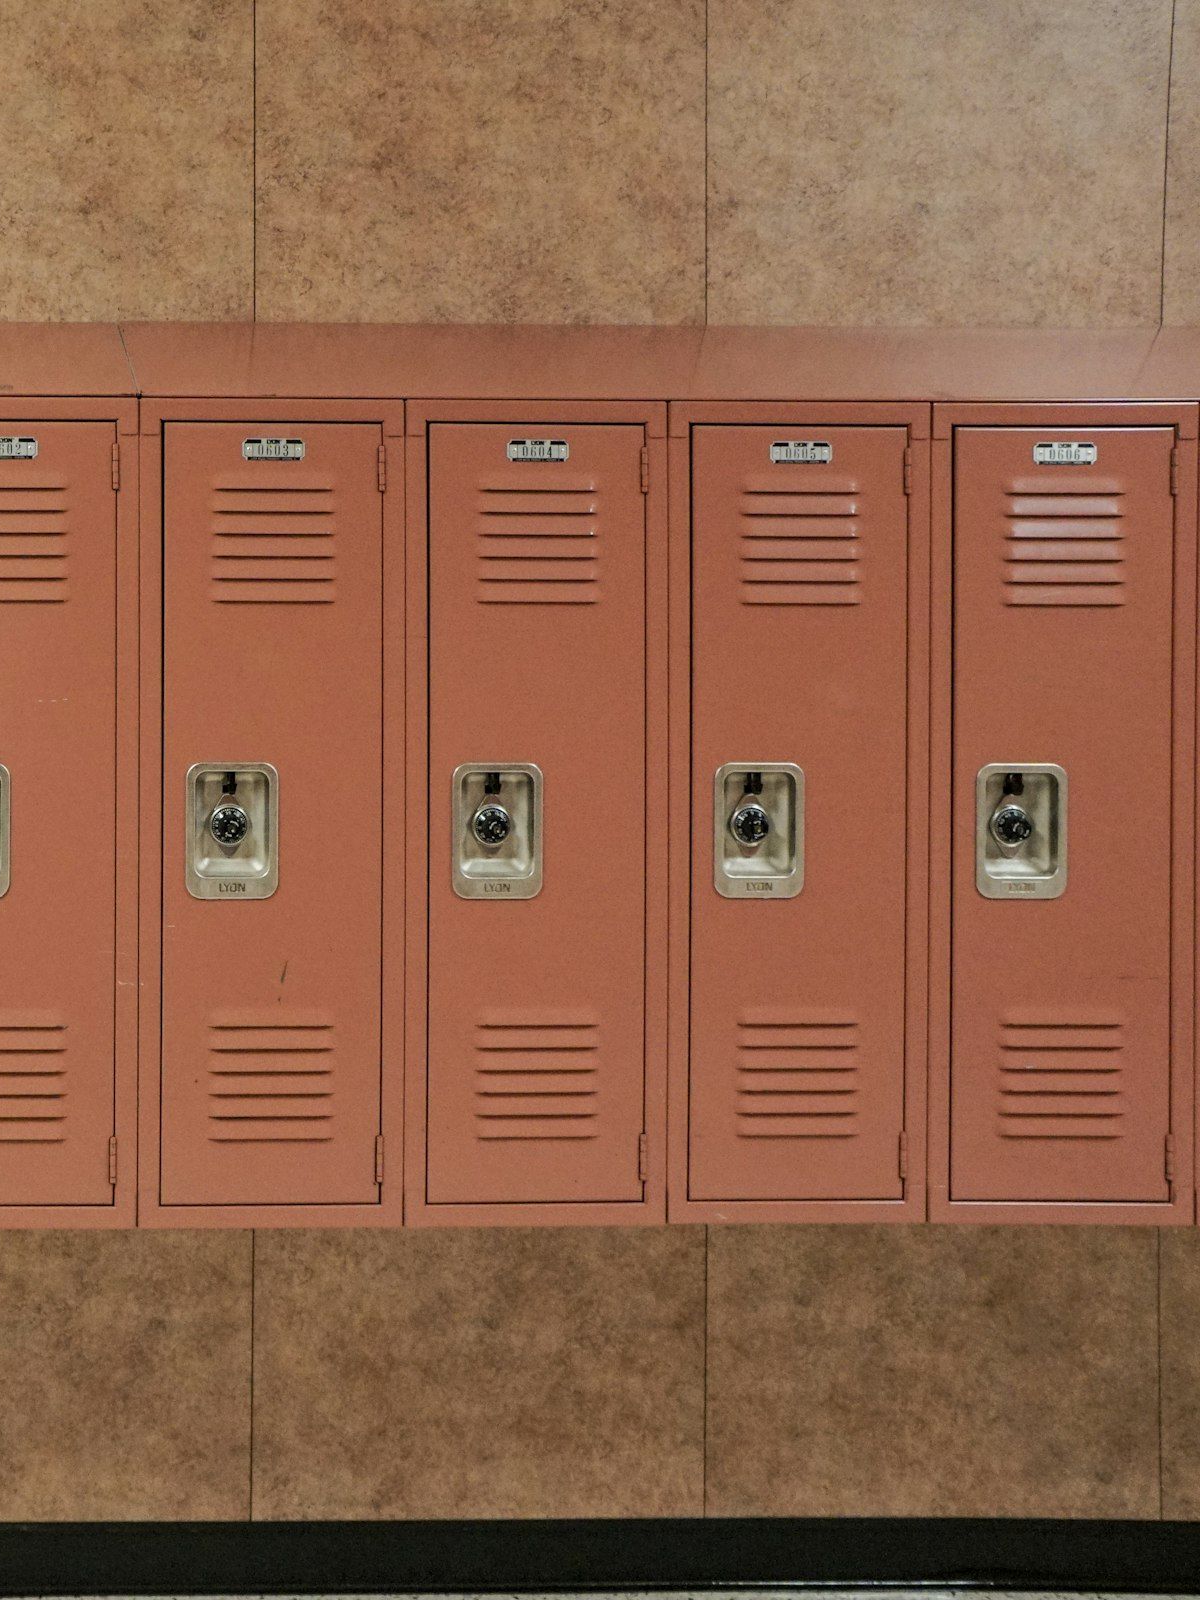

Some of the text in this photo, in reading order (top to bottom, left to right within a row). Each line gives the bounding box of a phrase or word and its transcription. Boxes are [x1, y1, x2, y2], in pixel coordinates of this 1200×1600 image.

[258, 444, 289, 457] 0603
[522, 445, 552, 457] 0604
[785, 447, 816, 460] 0605
[1049, 449, 1080, 461] 0606
[218, 882, 246, 893] LYON
[484, 883, 511, 893] LYON
[746, 882, 773, 892] LYON
